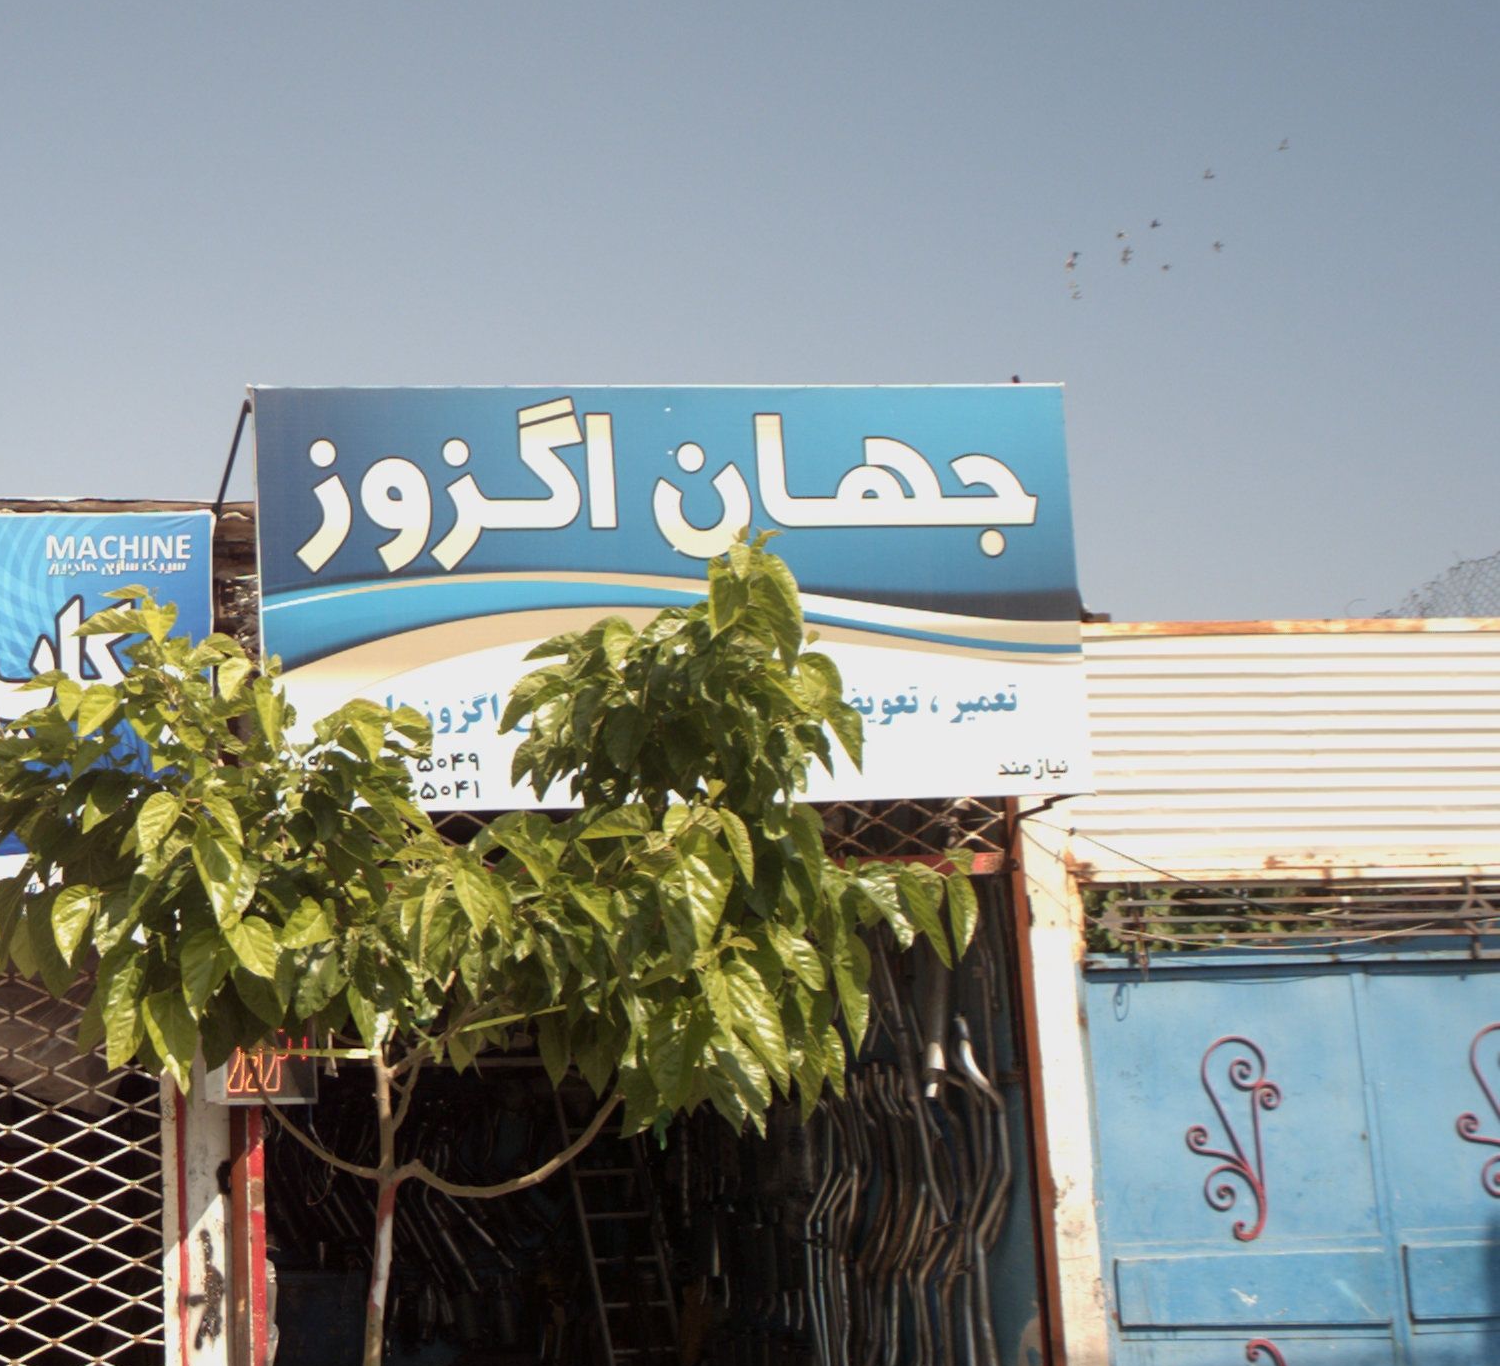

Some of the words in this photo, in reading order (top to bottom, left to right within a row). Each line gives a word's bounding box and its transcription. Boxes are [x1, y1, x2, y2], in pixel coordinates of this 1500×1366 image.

[296, 395, 619, 575] اگزوز
[651, 412, 1040, 560] جهان
[45, 534, 192, 560] MACHINE
[949, 684, 1018, 724] تعمیر
[997, 758, 1069, 780] نیازمند
